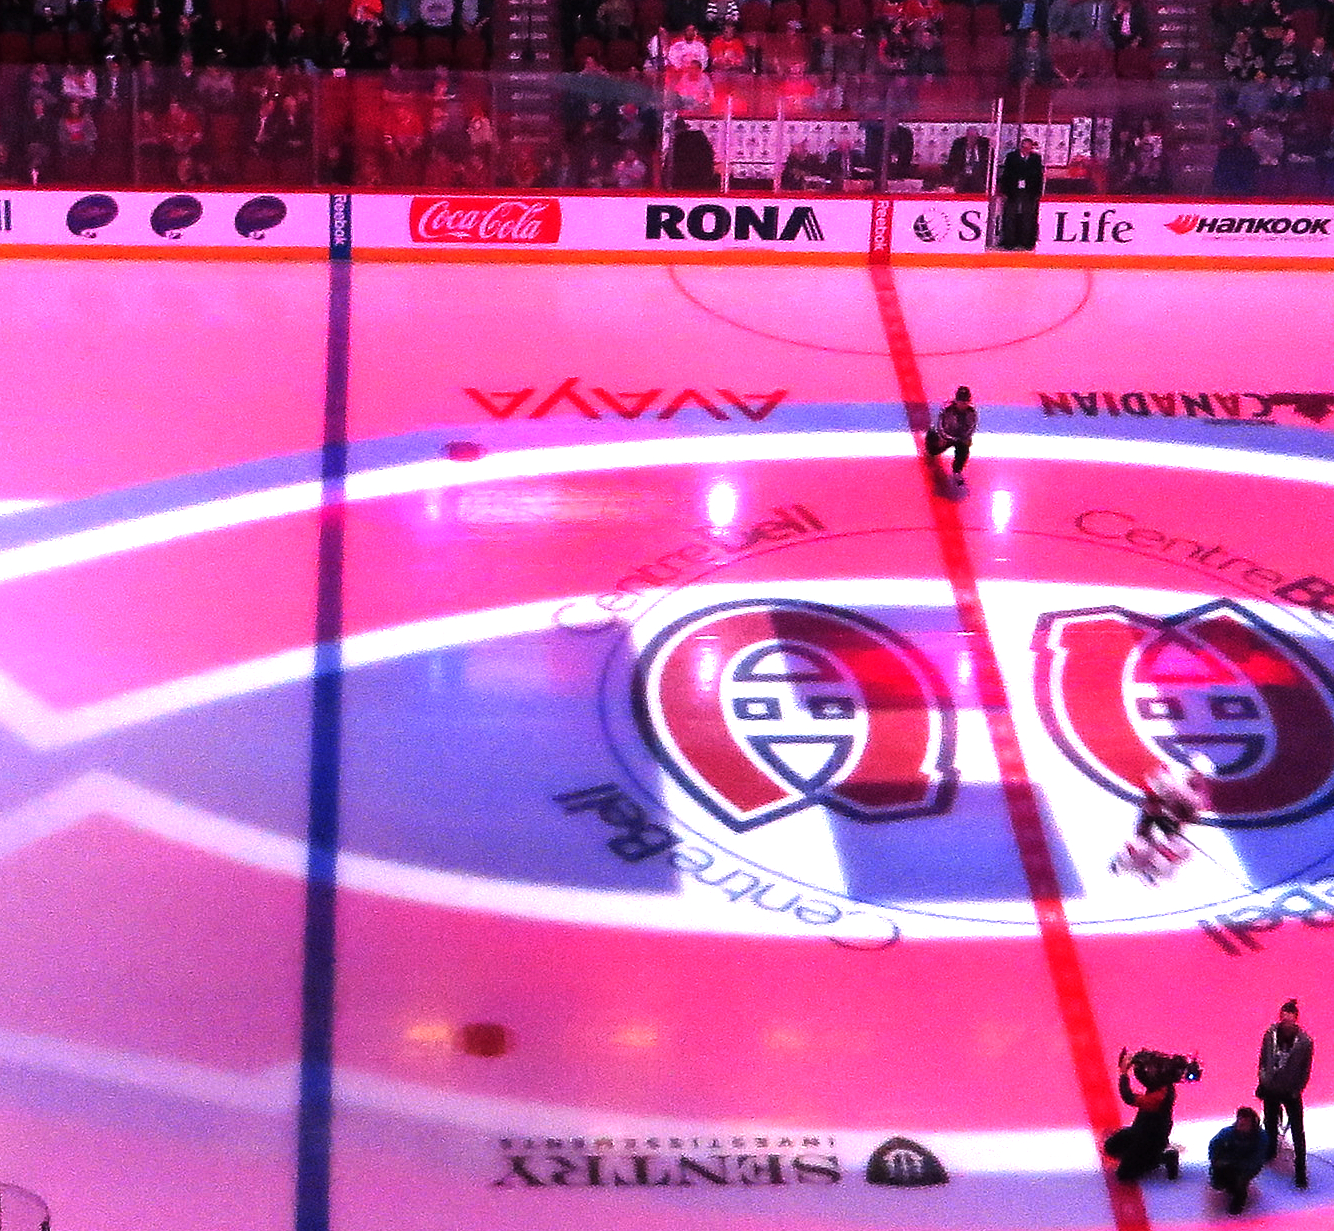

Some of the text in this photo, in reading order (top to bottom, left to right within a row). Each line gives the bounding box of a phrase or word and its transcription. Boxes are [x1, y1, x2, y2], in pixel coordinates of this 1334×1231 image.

[333, 194, 347, 245] Reebok
[645, 203, 826, 242] RONA
[873, 200, 890, 251] Reebok
[1053, 209, 1134, 243] Life
[463, 376, 789, 422] AVAYA
[1037, 391, 1274, 419] CANADIAN
[491, 1155, 842, 1187] SENTRY
